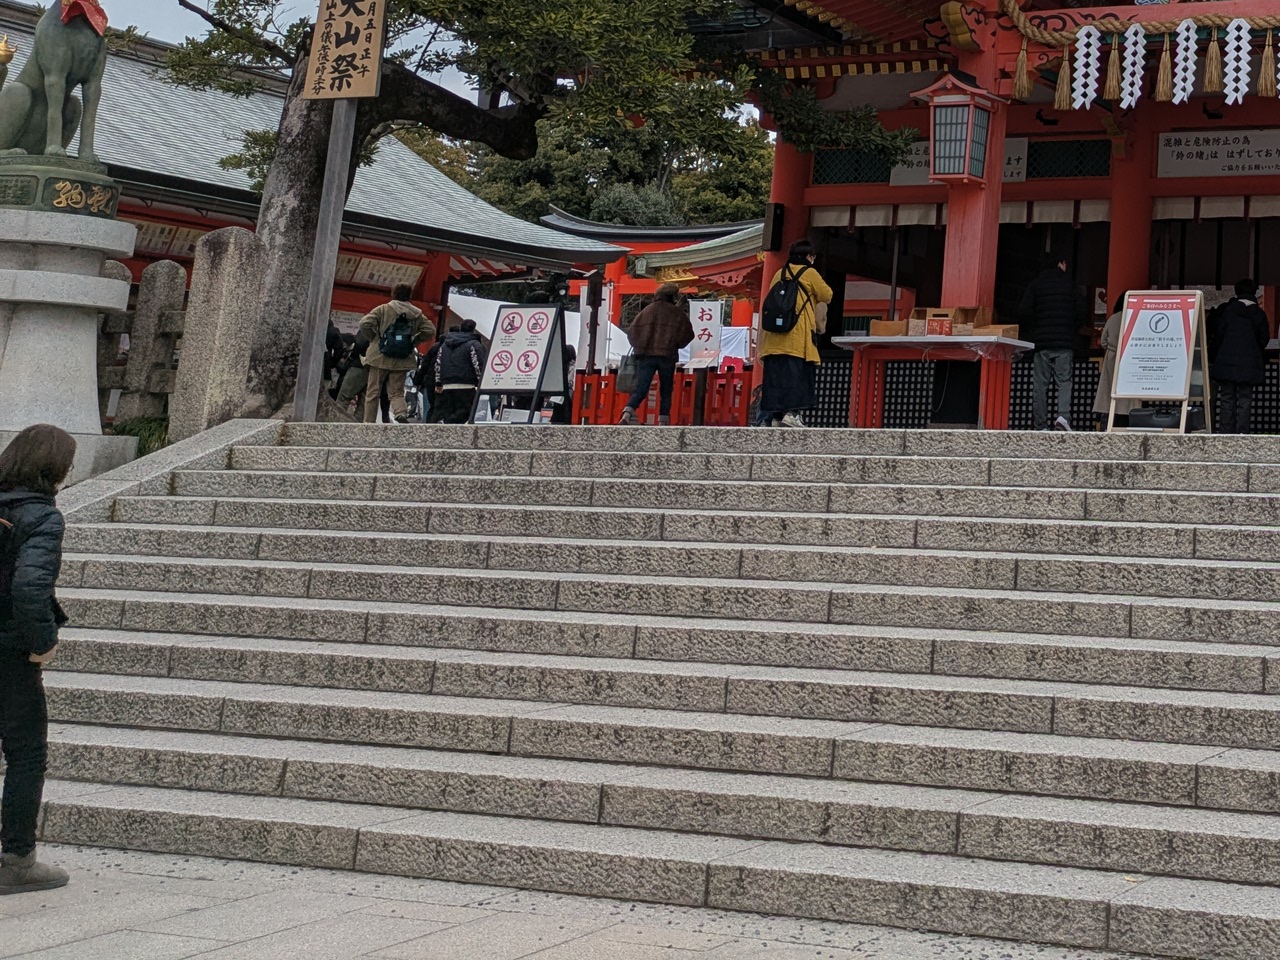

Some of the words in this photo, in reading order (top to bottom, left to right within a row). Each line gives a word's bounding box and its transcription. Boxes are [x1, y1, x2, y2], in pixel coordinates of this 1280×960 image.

[1163, 135, 1251, 148] 混雑と危険防止の為
[697, 306, 714, 351] おみ
